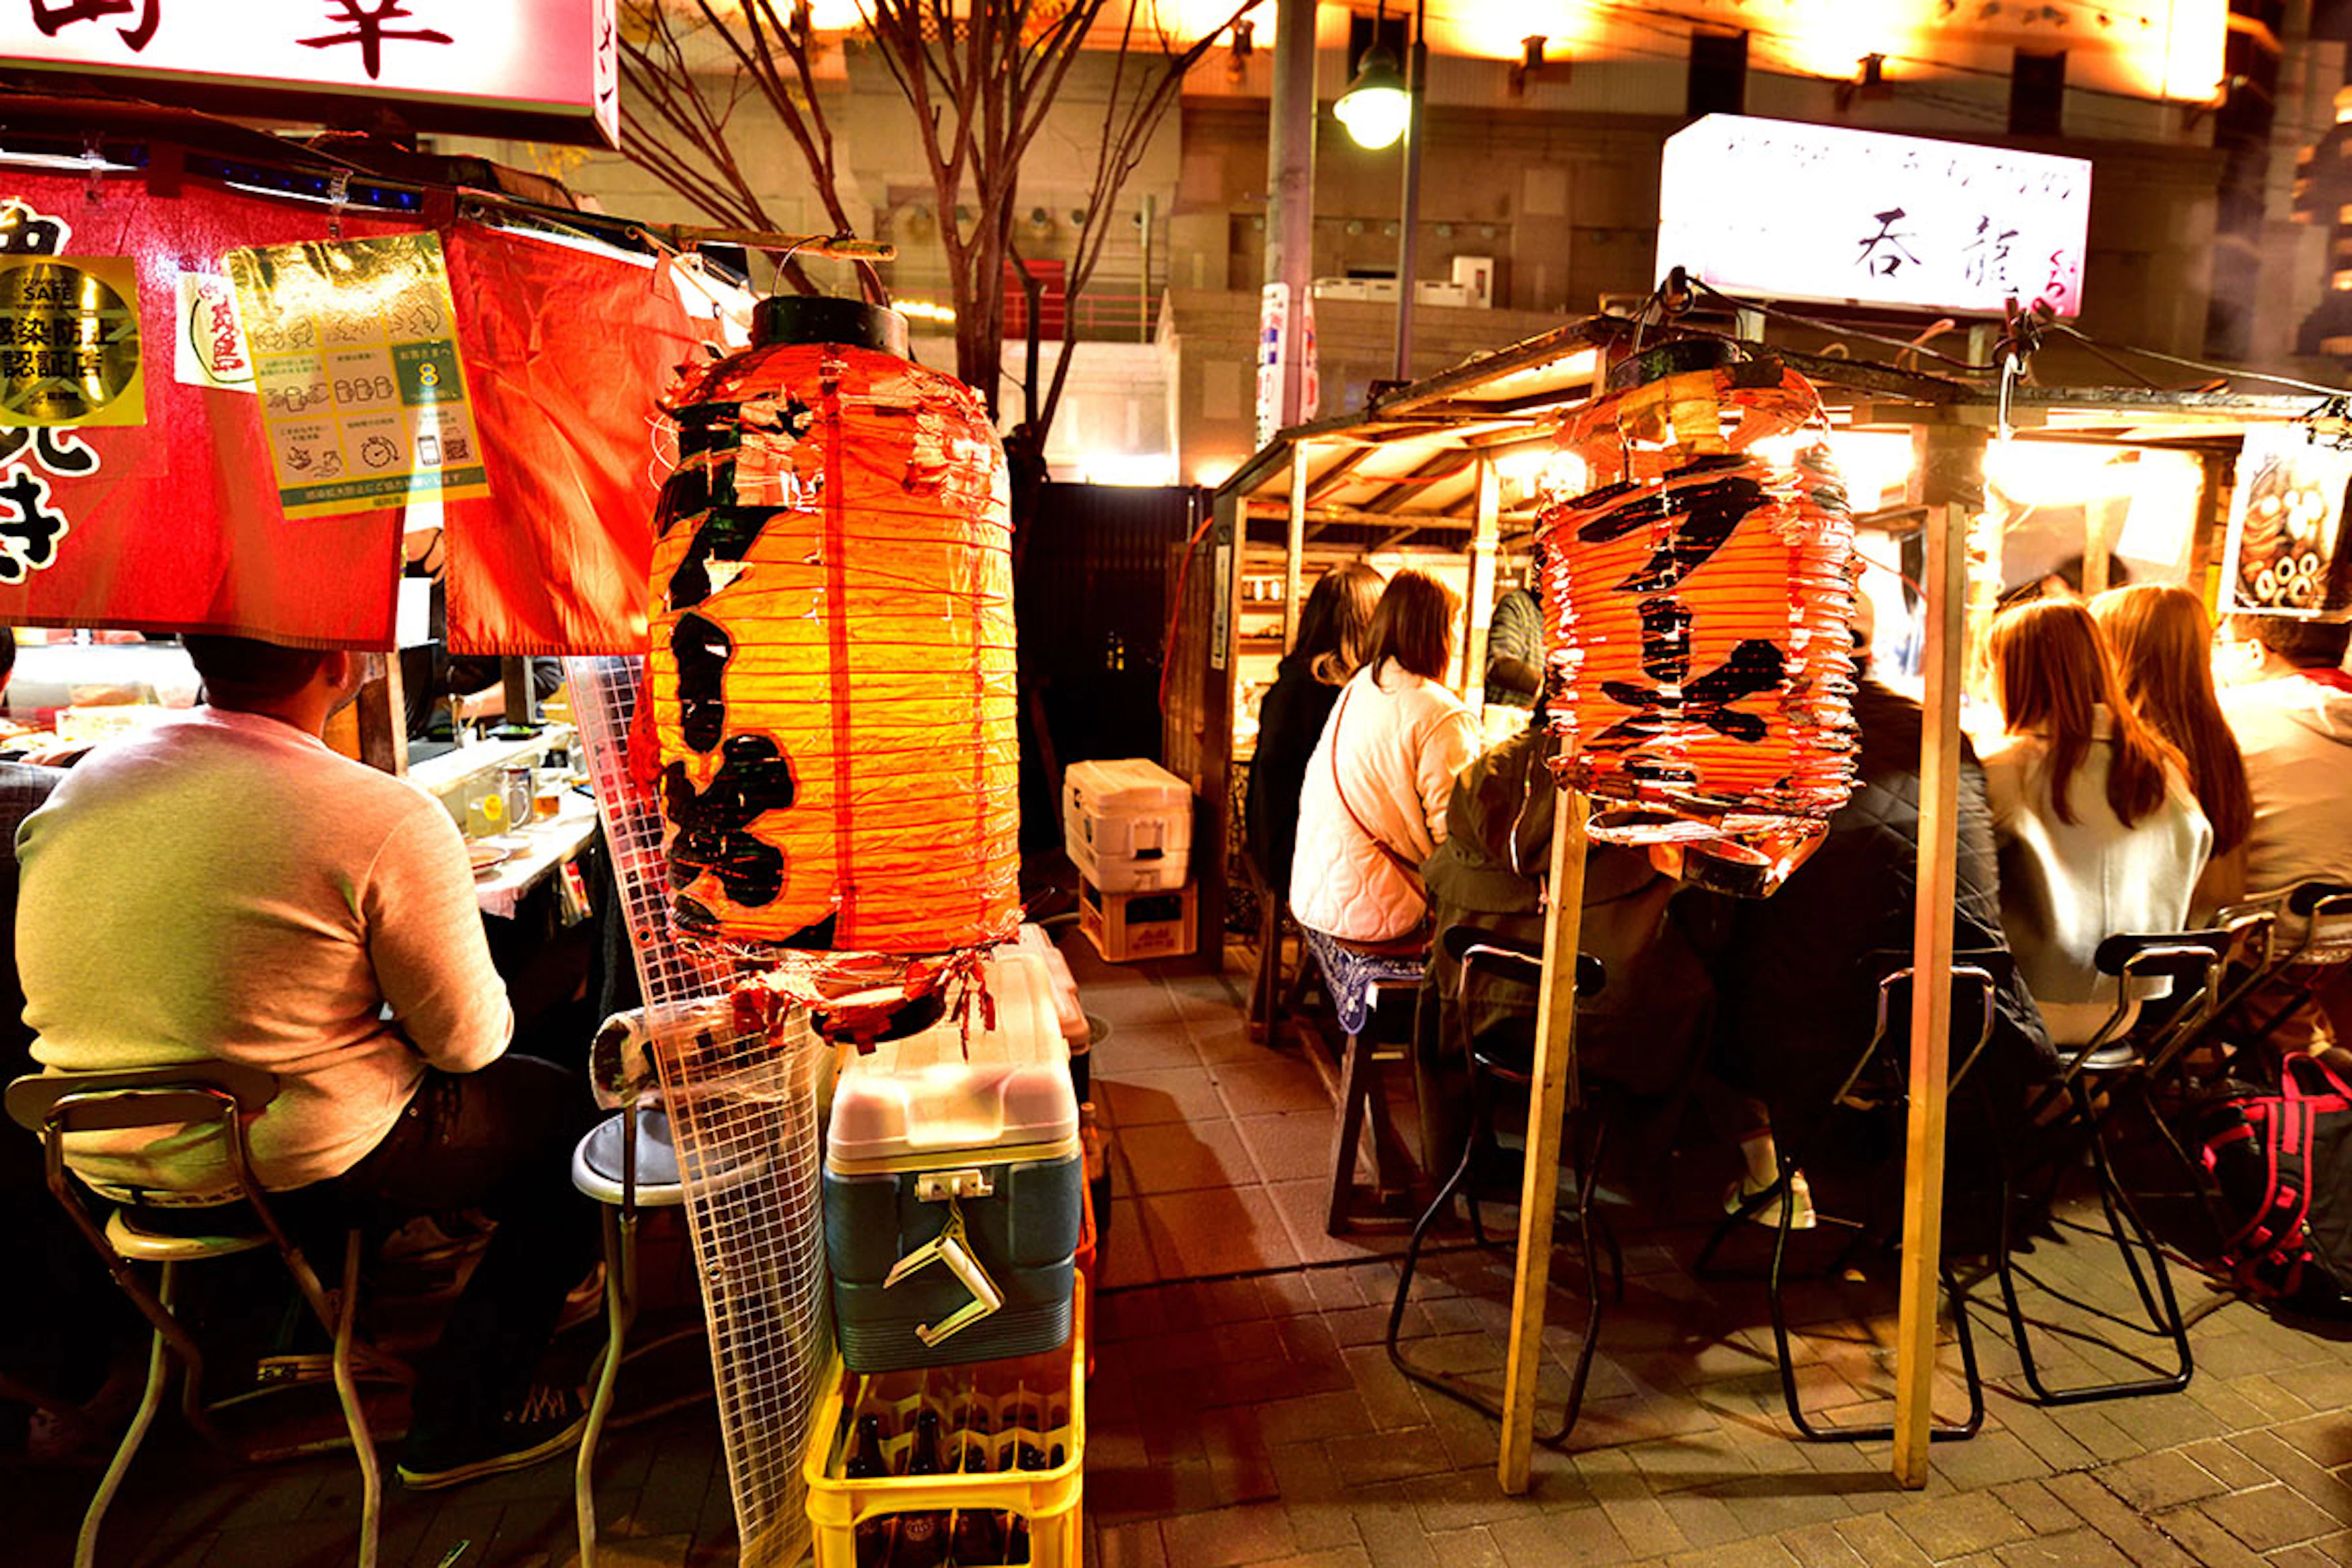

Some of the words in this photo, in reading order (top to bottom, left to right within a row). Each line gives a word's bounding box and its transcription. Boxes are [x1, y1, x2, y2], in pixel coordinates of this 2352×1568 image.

[24, 287, 72, 301] SAFE
[2, 351, 102, 378] 認証店
[418, 362, 440, 386] 8
